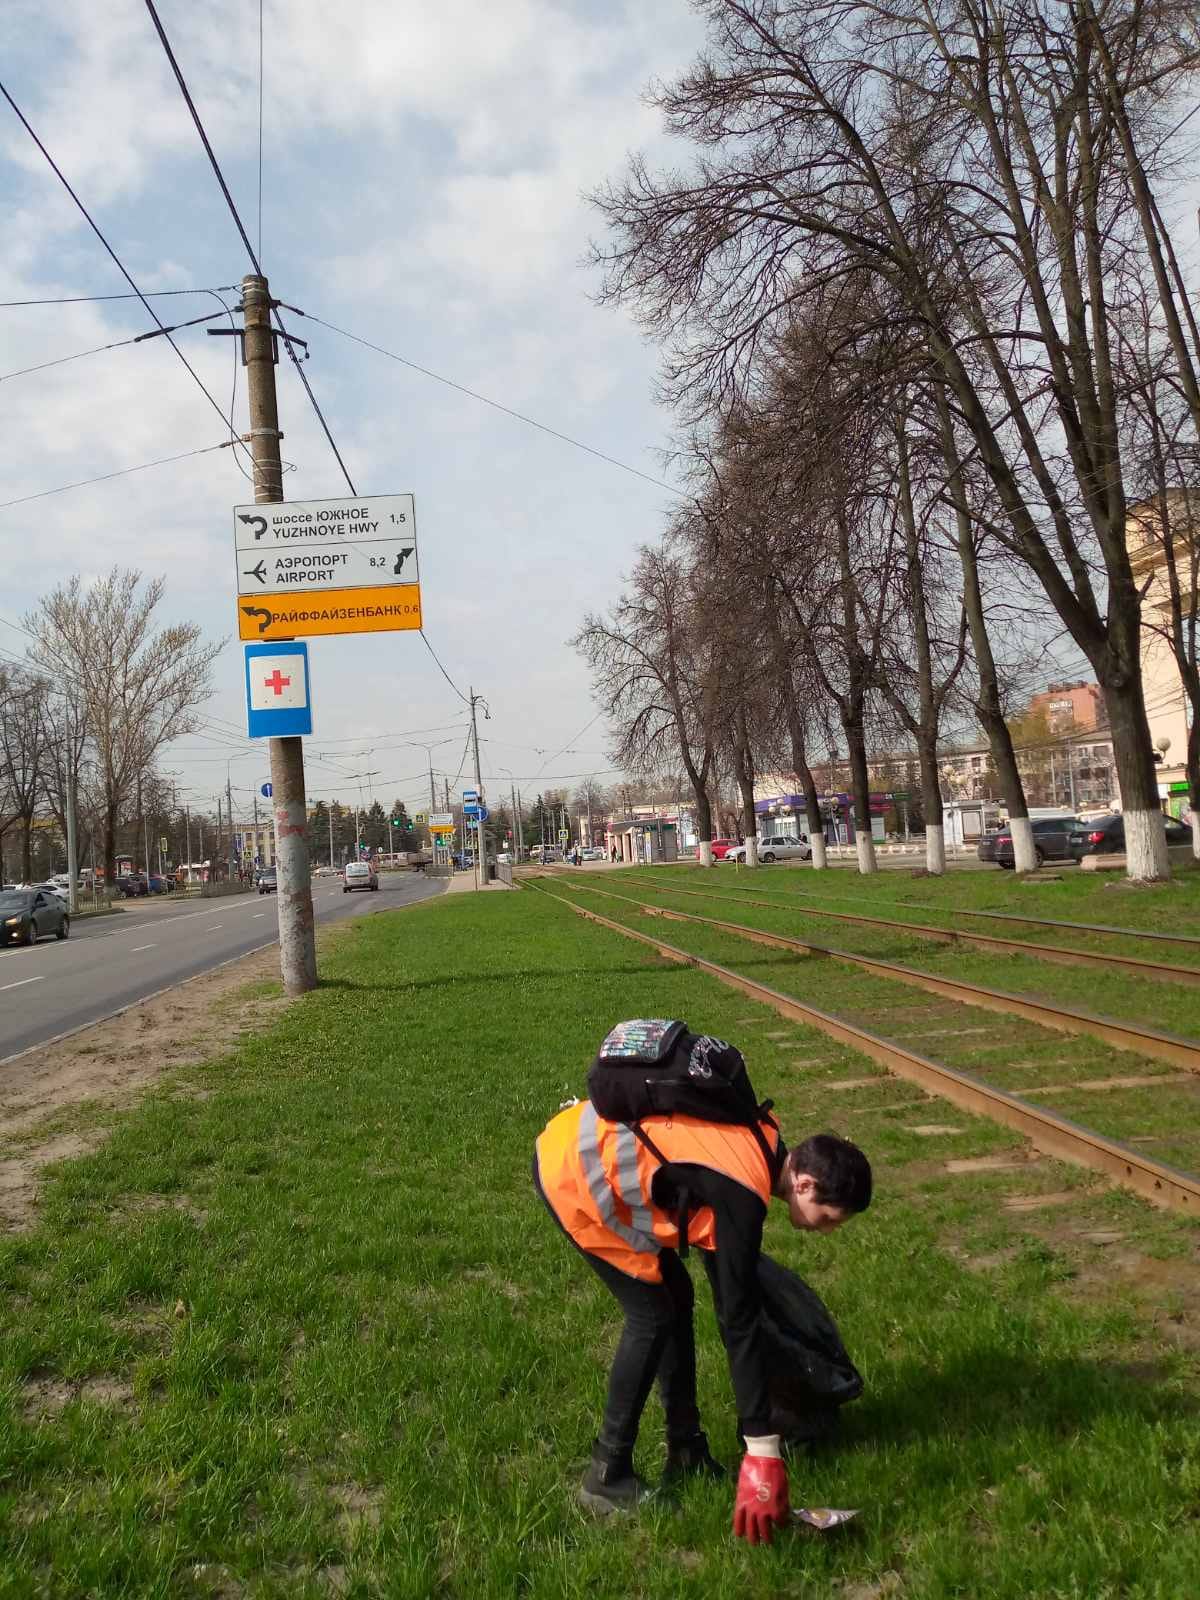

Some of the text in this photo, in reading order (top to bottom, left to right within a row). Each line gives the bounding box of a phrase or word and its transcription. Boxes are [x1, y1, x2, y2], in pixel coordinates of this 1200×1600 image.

[272, 508, 368, 524] шоссе ЮЖНОЕ
[390, 513, 406, 525] 1,5
[273, 521, 379, 539] YUZHNOYE HWY
[275, 554, 348, 569] АЭРОПОРТ
[369, 557, 386, 567] 8,2
[276, 570, 335, 583] AIRPORT
[272, 605, 401, 623] РАЙФФАЙЗЕНБАНК
